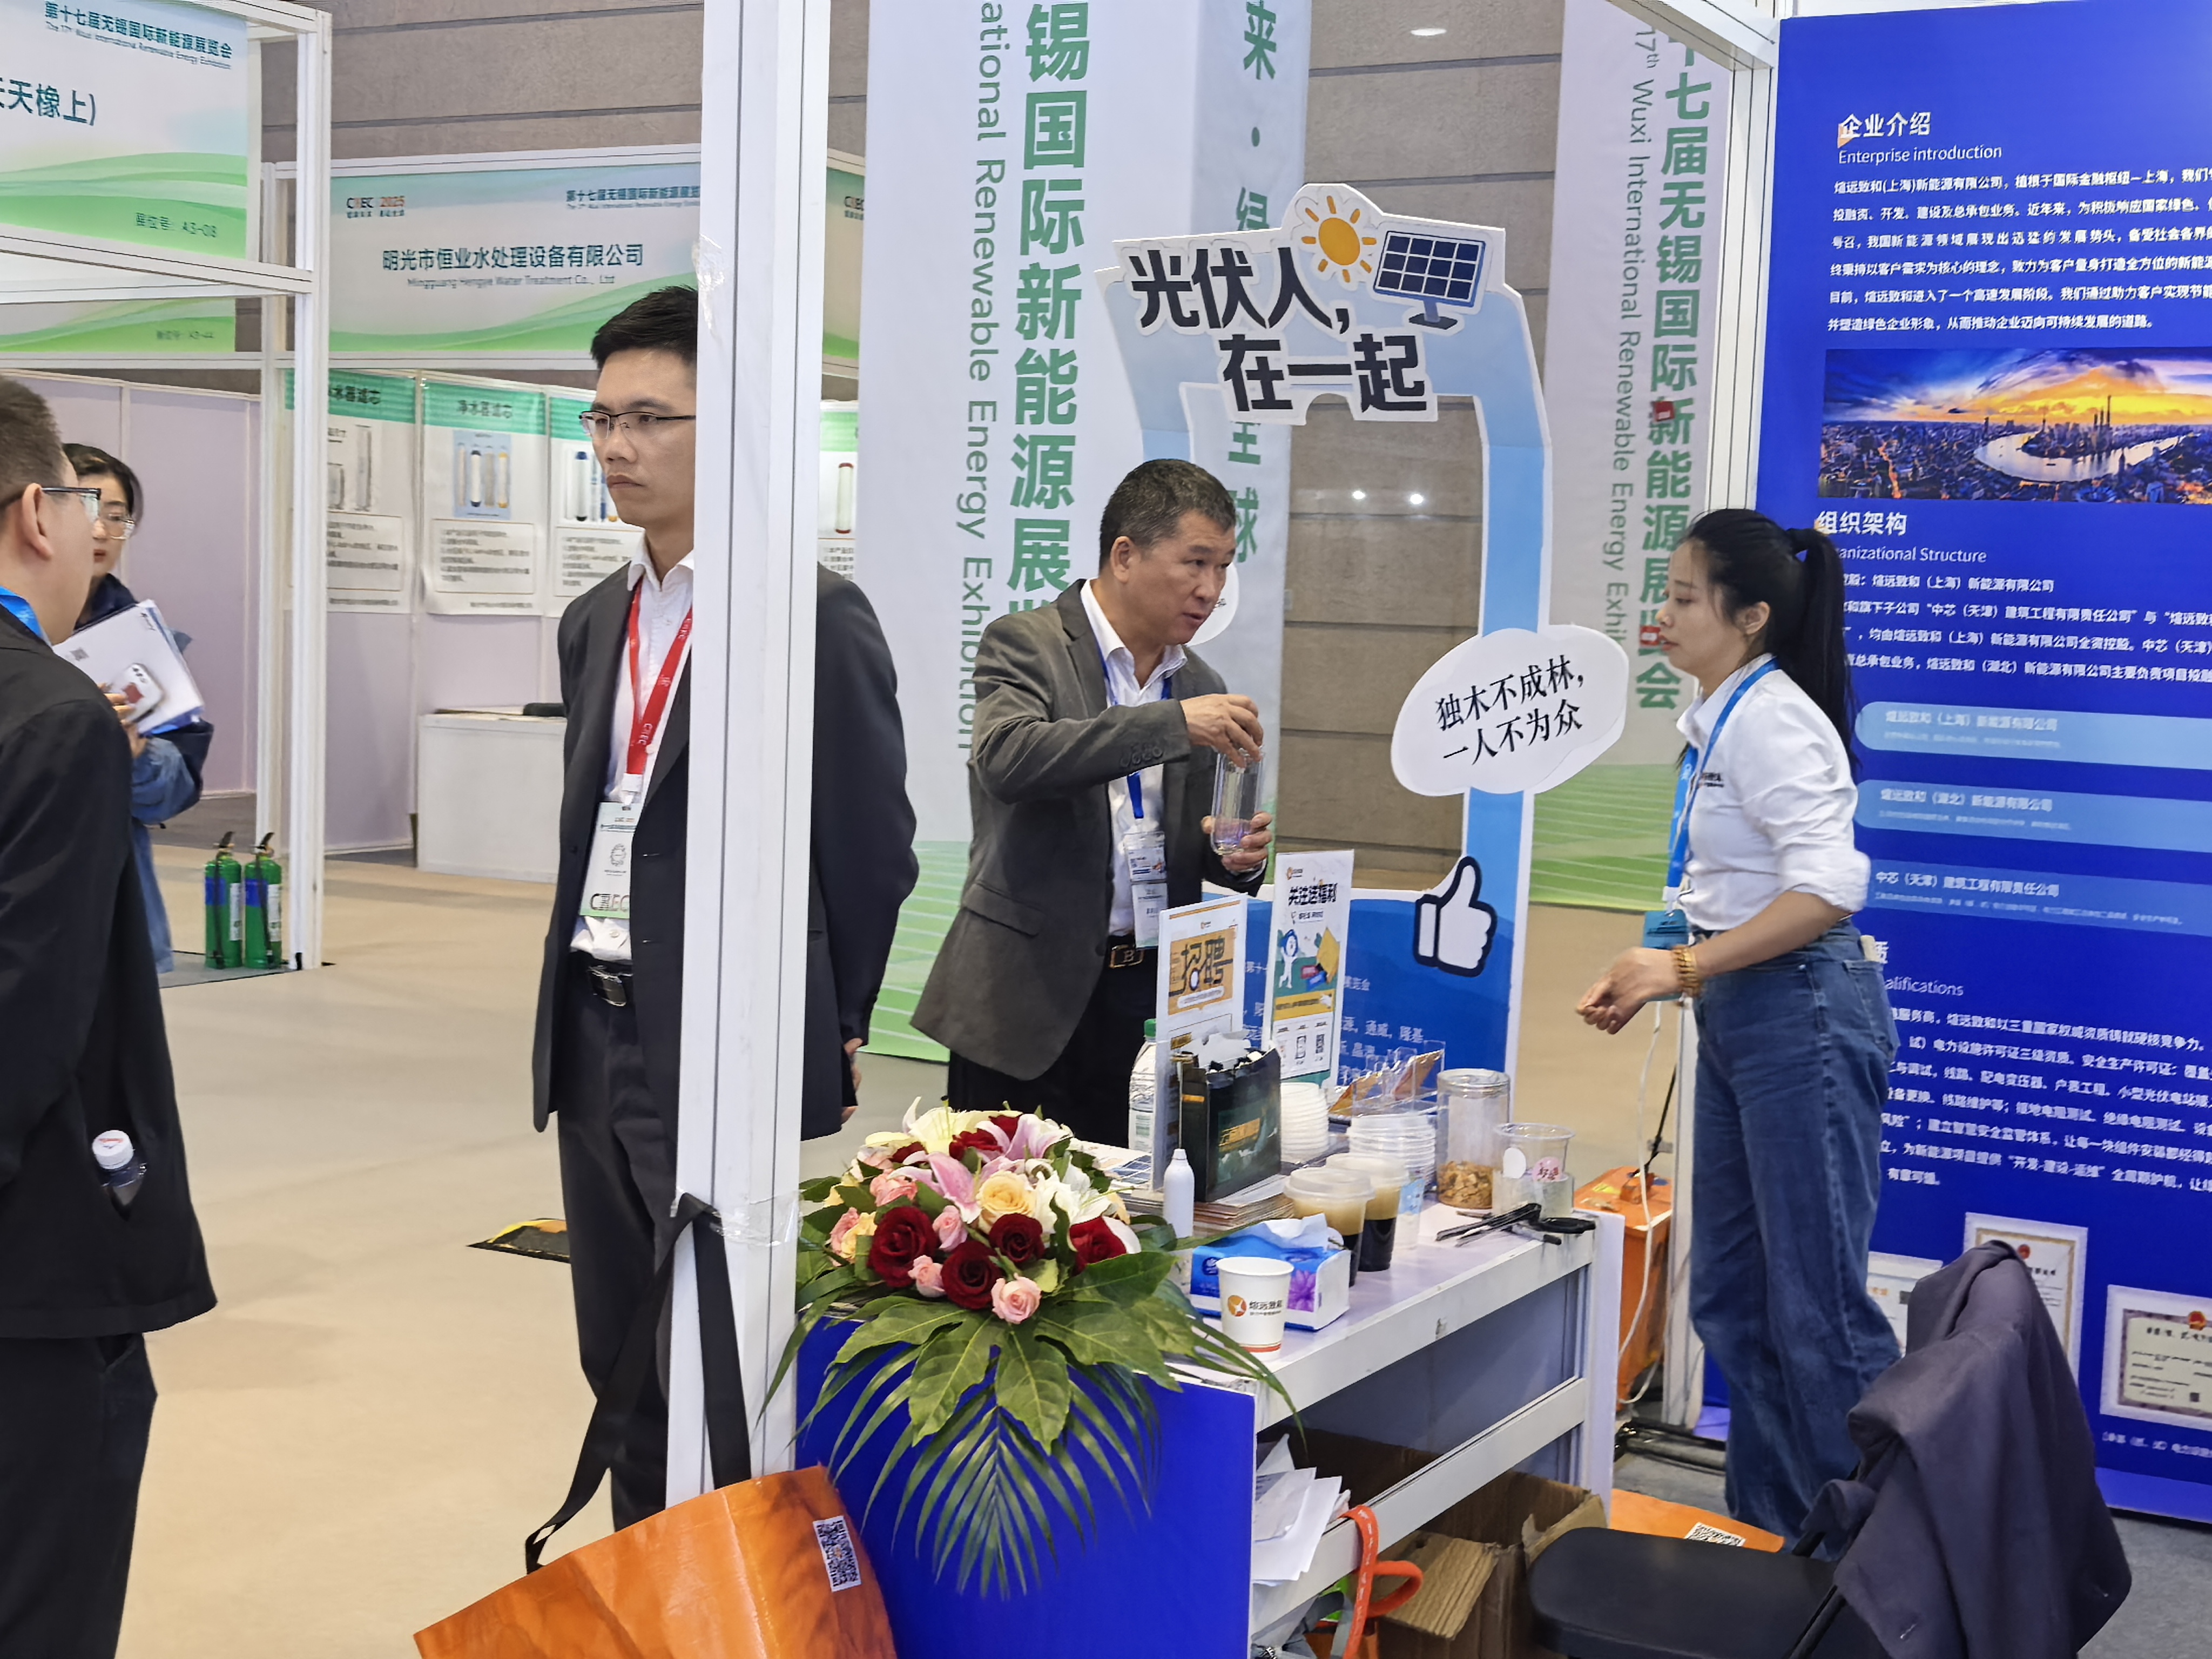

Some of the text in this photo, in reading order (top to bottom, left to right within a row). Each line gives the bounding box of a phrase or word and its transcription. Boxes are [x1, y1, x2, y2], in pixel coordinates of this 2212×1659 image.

[977, 0, 1010, 141] ational
[1627, 79, 1654, 144] Wuxi
[1838, 111, 1932, 138] 企业介绍
[1838, 145, 2002, 165] Enterprise introduction
[382, 244, 644, 271] 明光市恒业水处理设备有限公司
[969, 160, 1006, 381] Renewable
[1620, 156, 1650, 320] International
[1007, 4, 1090, 613] 锡国际新能源展
[1219, 333, 1427, 413] 在一起
[1613, 331, 1642, 471] Renewable
[956, 401, 997, 539] Energy
[1603, 482, 1634, 571] Energy
[1817, 510, 1907, 536] 组织架构
[1837, 545, 1987, 563] anizational Structure
[1443, 699, 1583, 765] 一人不为众
[1874, 941, 1889, 964] 质
[1885, 976, 1964, 996] alifications
